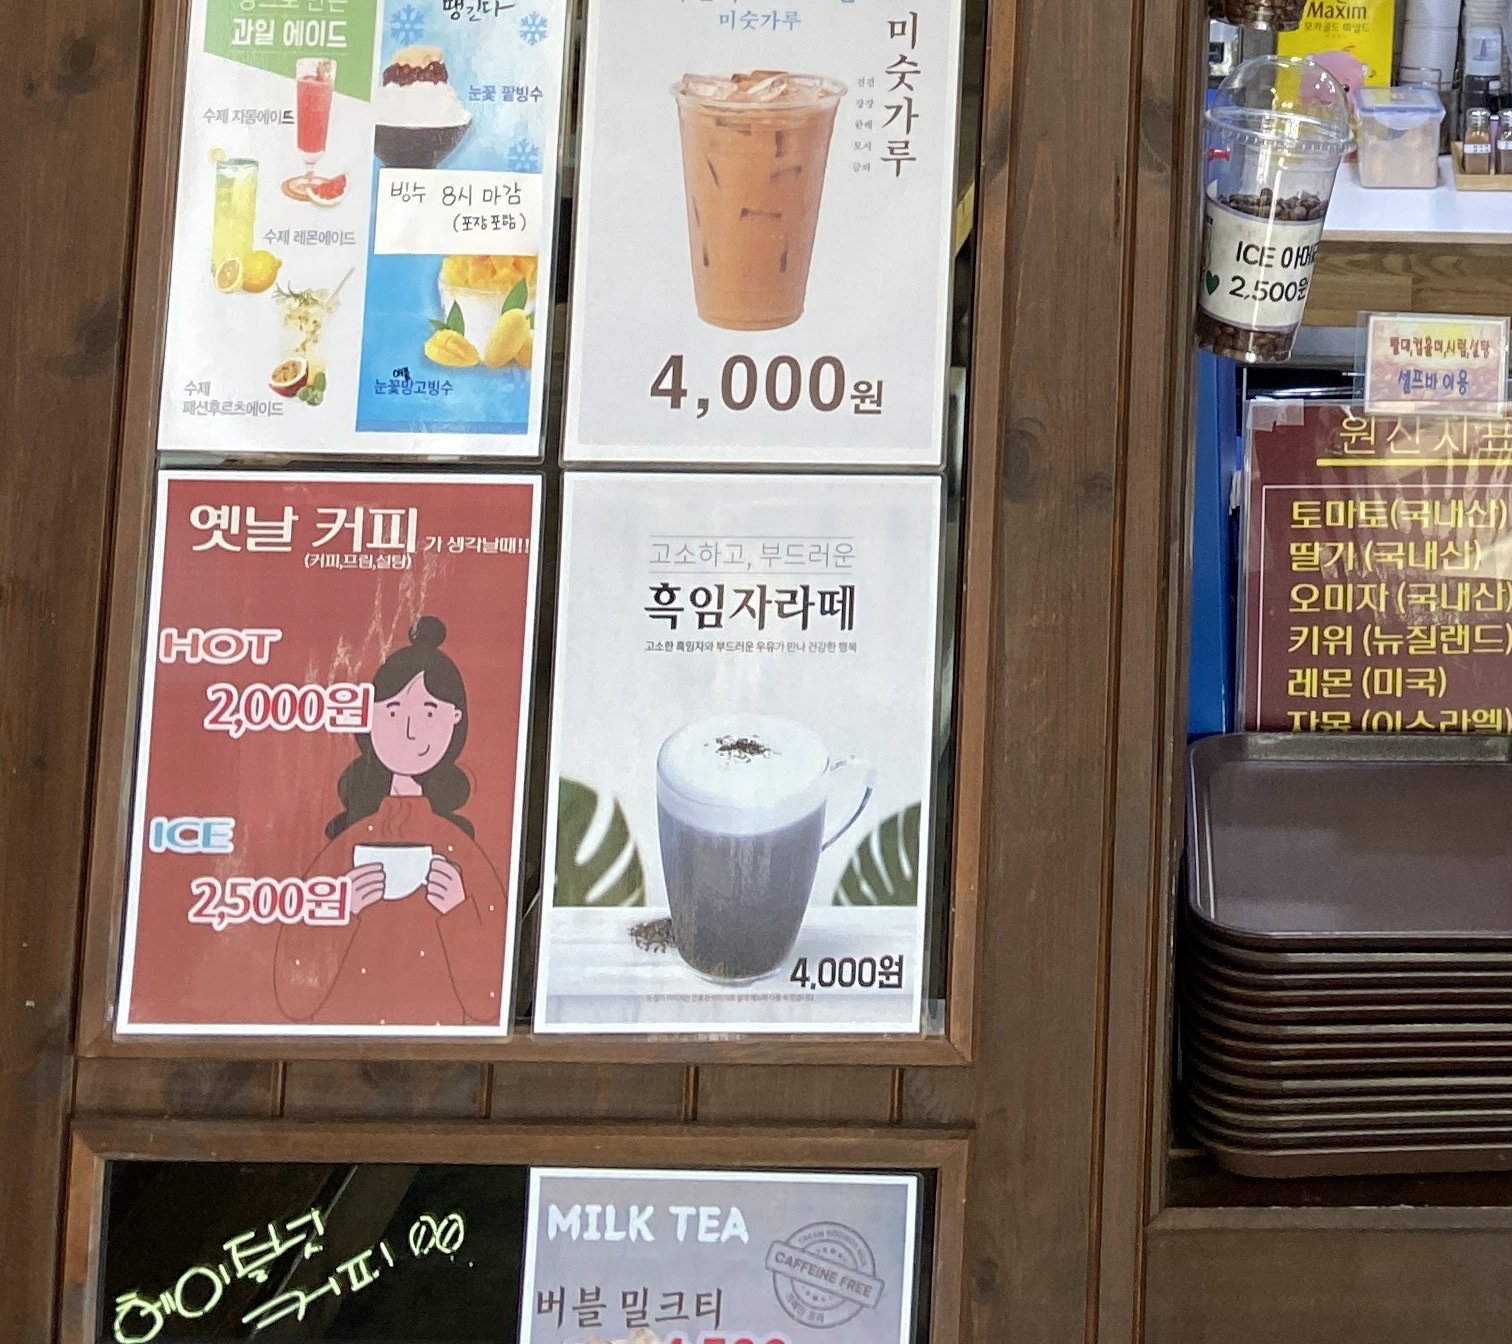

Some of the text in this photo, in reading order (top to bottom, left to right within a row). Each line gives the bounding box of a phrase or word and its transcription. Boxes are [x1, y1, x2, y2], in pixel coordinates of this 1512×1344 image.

[232, 20, 347, 48] 과일 에이드
[719, 10, 801, 32] 미숫가루
[880, 11, 921, 178] 미숫가루
[390, 181, 521, 206] 빙수 8시 마감
[264, 229, 356, 246] 수제 레몬에이드
[1236, 241, 1276, 267] ICE
[184, 381, 210, 396] 수제
[650, 354, 884, 418] 4,000원
[1443, 370, 1468, 395] 이용
[189, 504, 297, 552] 옛날
[312, 507, 418, 553] 커피
[1291, 499, 1507, 530] 토마토(국내산)
[648, 542, 856, 569] 고소하고, 부드러운
[1290, 541, 1481, 572] 딸기 (국내산)
[644, 582, 856, 632] 흑임자라떼
[160, 628, 280, 664] HOT
[645, 641, 674, 652] 고소한
[716, 641, 754, 652] 부드러운
[204, 683, 374, 738] 2,000원
[149, 818, 234, 853] ICE
[189, 877, 352, 929] 2,500원
[547, 1204, 748, 1244] MILK TEA
[775, 1251, 872, 1298] CAFFEINE FREE
[537, 1285, 723, 1330] 버블 밀크티
